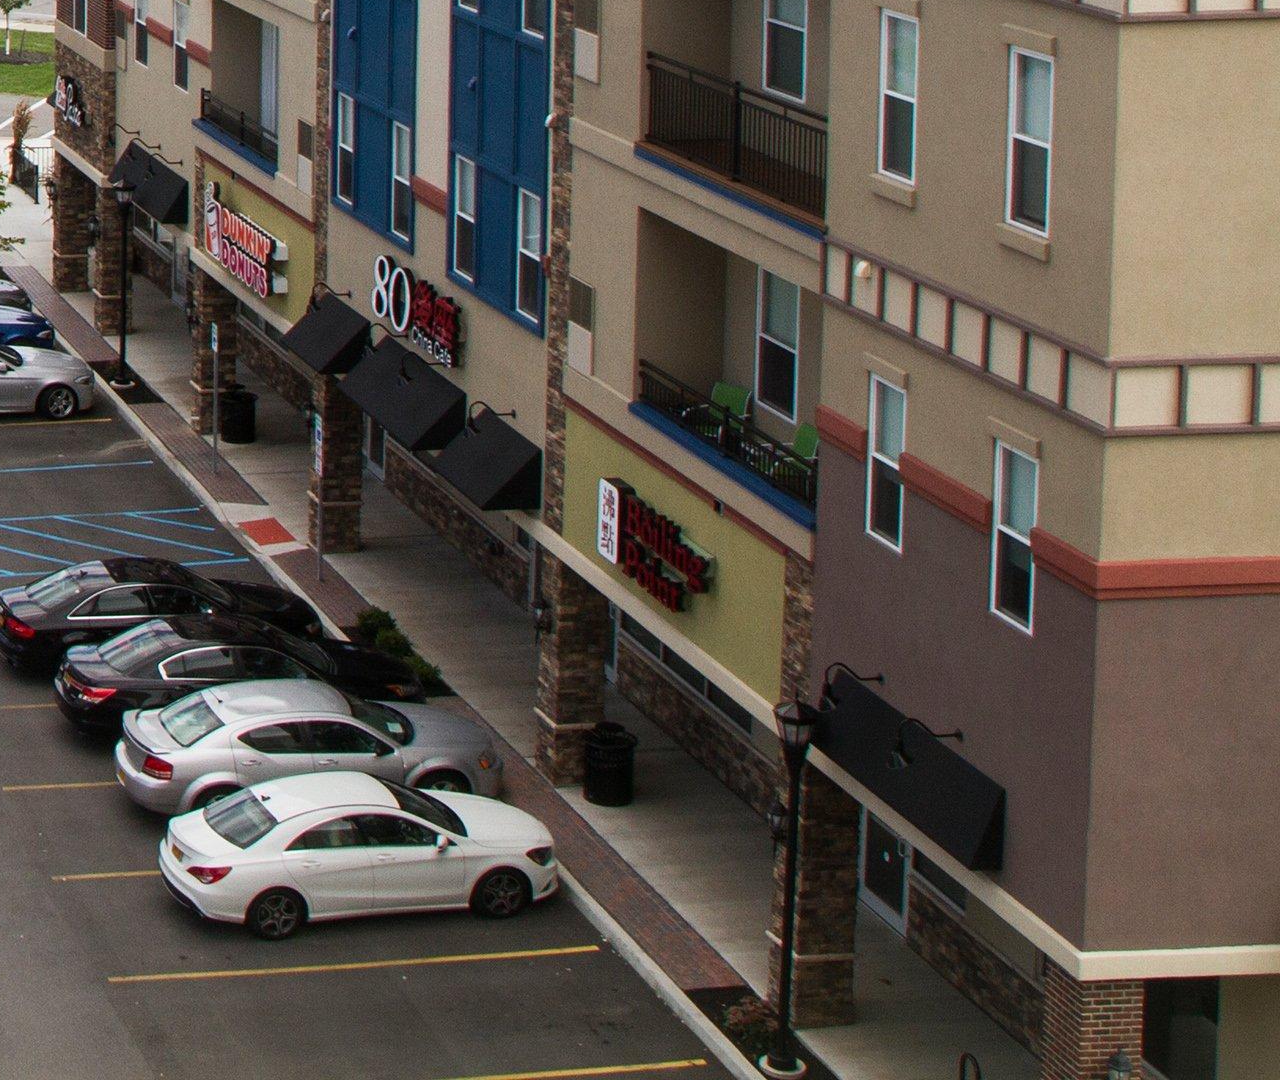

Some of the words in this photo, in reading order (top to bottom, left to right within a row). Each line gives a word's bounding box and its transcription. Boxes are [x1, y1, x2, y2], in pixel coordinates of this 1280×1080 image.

[221, 207, 271, 266] DUNKIN'
[221, 238, 268, 299] DONUTS
[371, 255, 411, 332] 80
[412, 325, 433, 355] China
[622, 539, 682, 614] Point
[626, 494, 708, 594] Boiling
